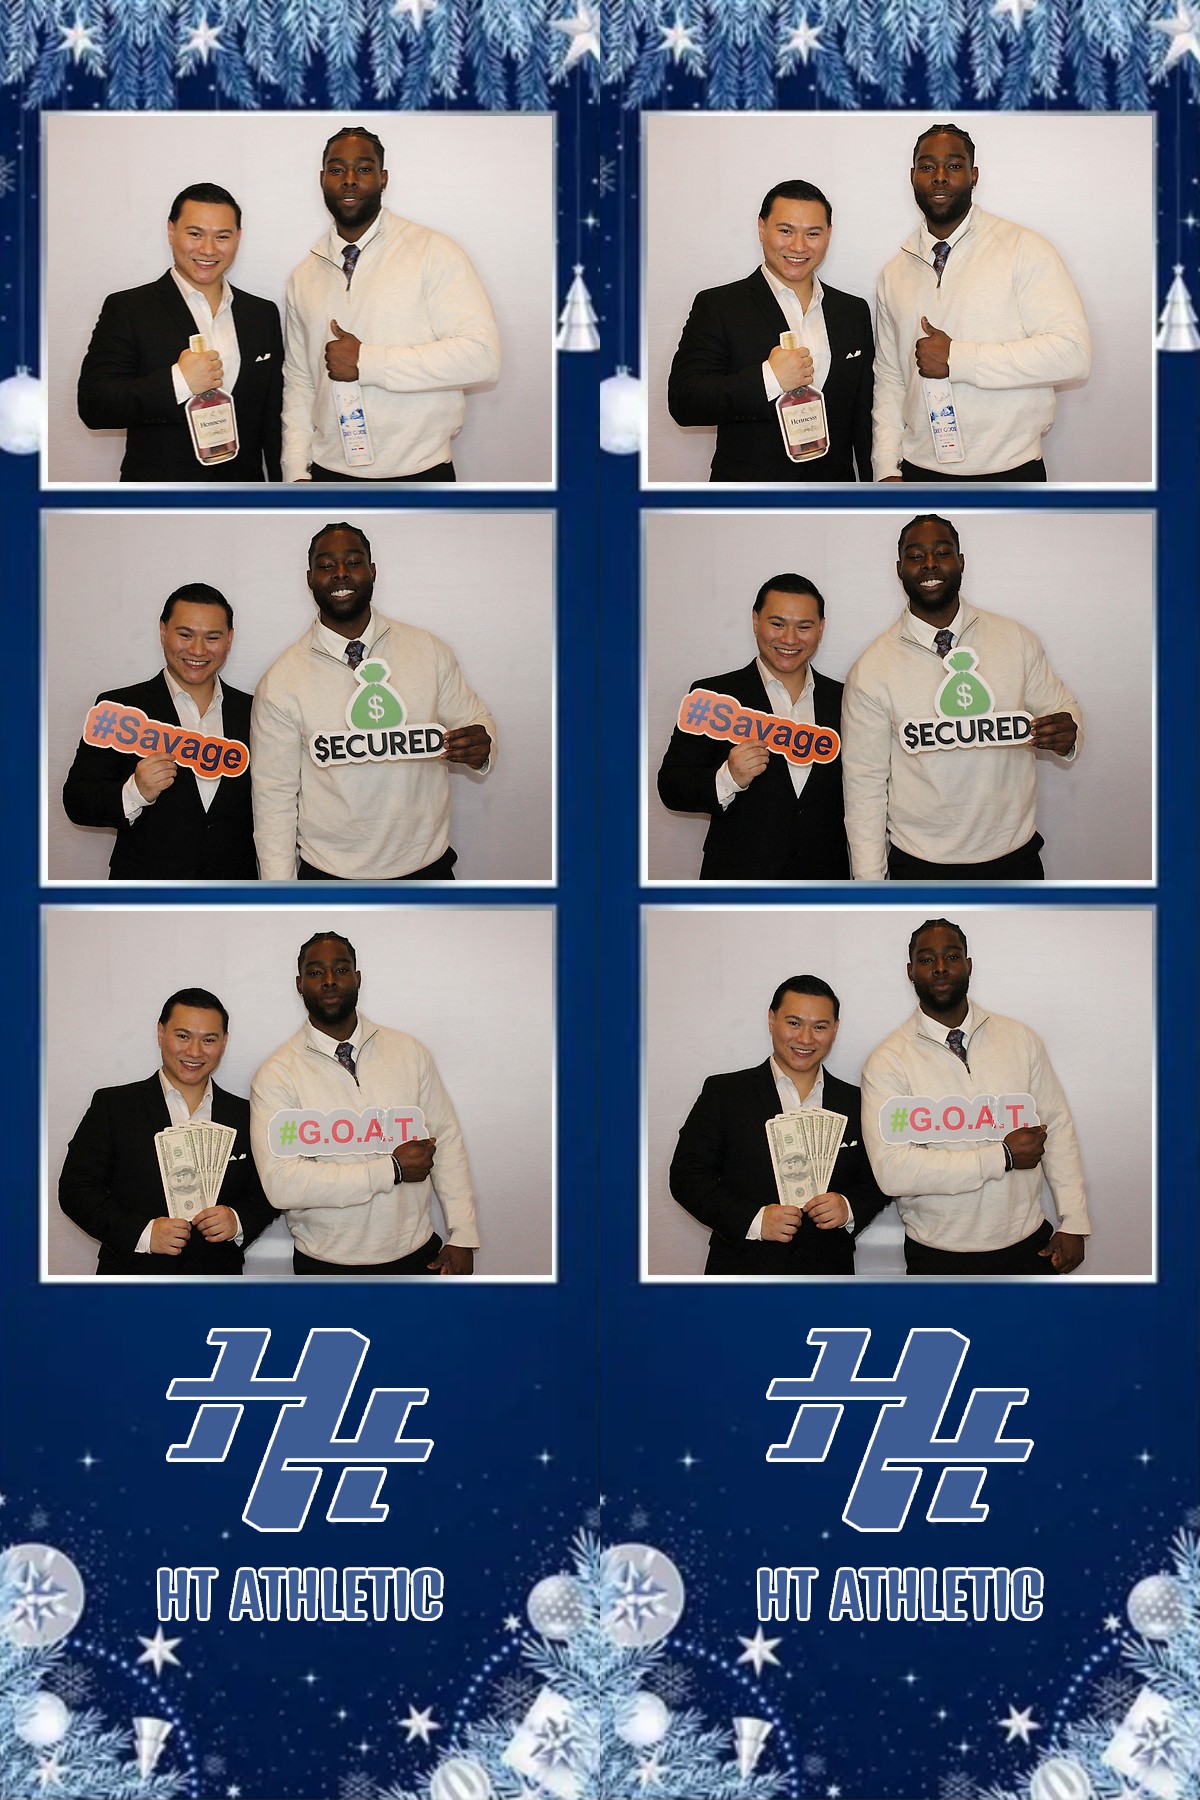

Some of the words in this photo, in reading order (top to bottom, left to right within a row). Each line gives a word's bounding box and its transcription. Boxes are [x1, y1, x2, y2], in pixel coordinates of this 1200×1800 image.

[91, 709, 242, 772] #Savage
[314, 728, 444, 763] $ECURED
[686, 697, 833, 758] #Savage
[903, 715, 1032, 750] $ECURED
